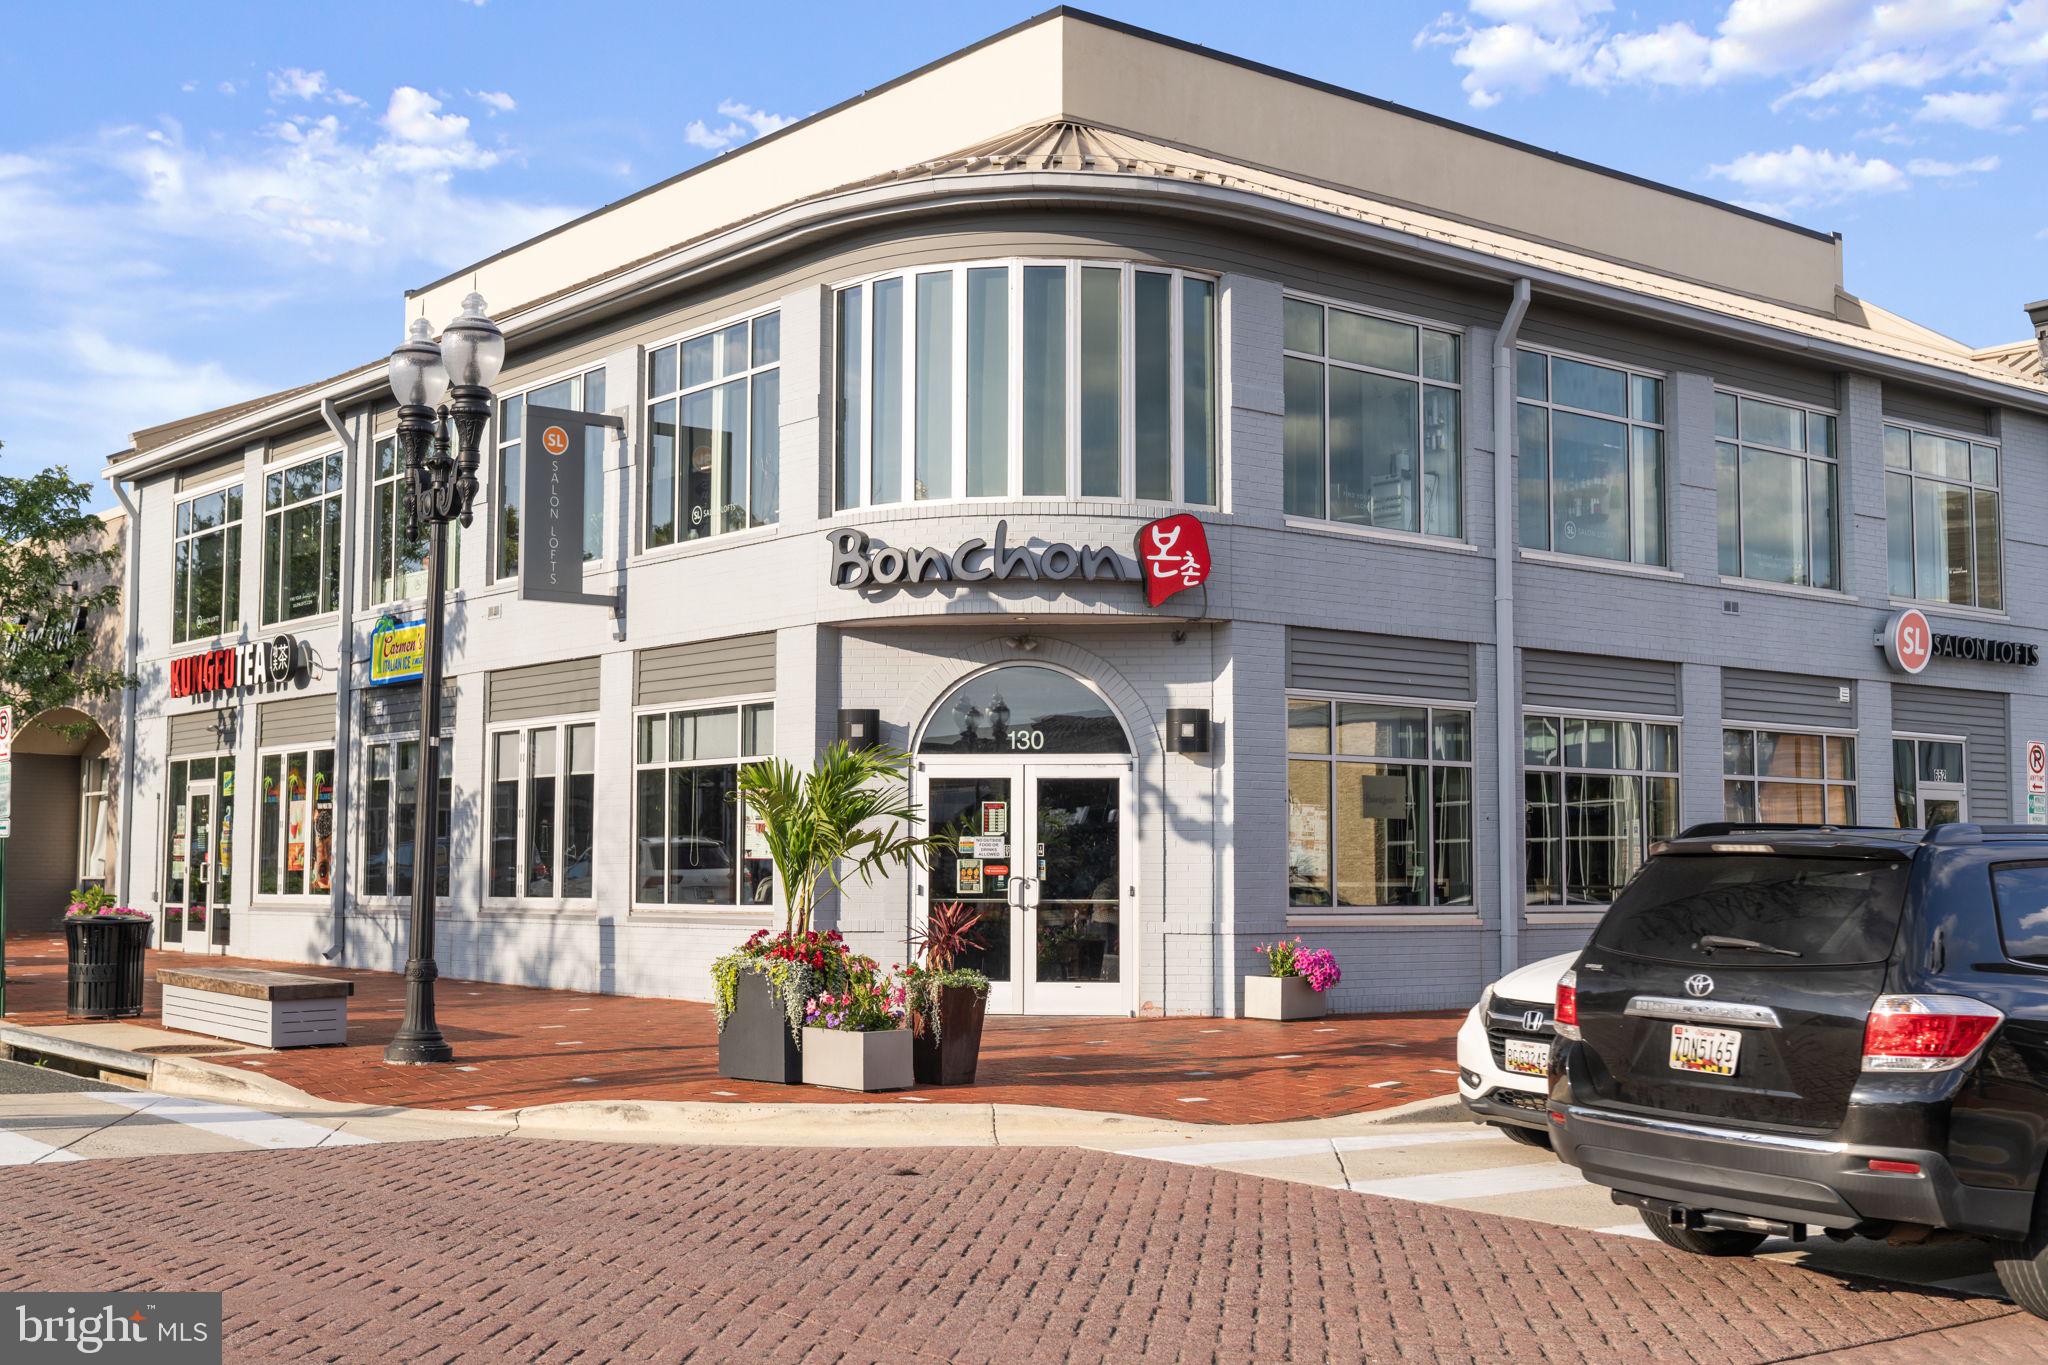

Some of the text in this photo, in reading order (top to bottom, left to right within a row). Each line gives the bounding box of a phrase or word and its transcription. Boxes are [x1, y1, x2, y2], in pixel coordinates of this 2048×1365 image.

[547, 433, 564, 448] SL
[548, 461, 560, 585] SALON LOFTS
[826, 519, 1127, 591] Bonchon
[1147, 525, 1202, 587] 본촌
[383, 633, 423, 658] Carmen's
[1903, 627, 1925, 656] SL
[1933, 633, 2040, 667] SALON LOFTS
[403, 656, 411, 670] ICE
[1007, 730, 1045, 750] 130
[1674, 1036, 1735, 1063] 7DN5165
